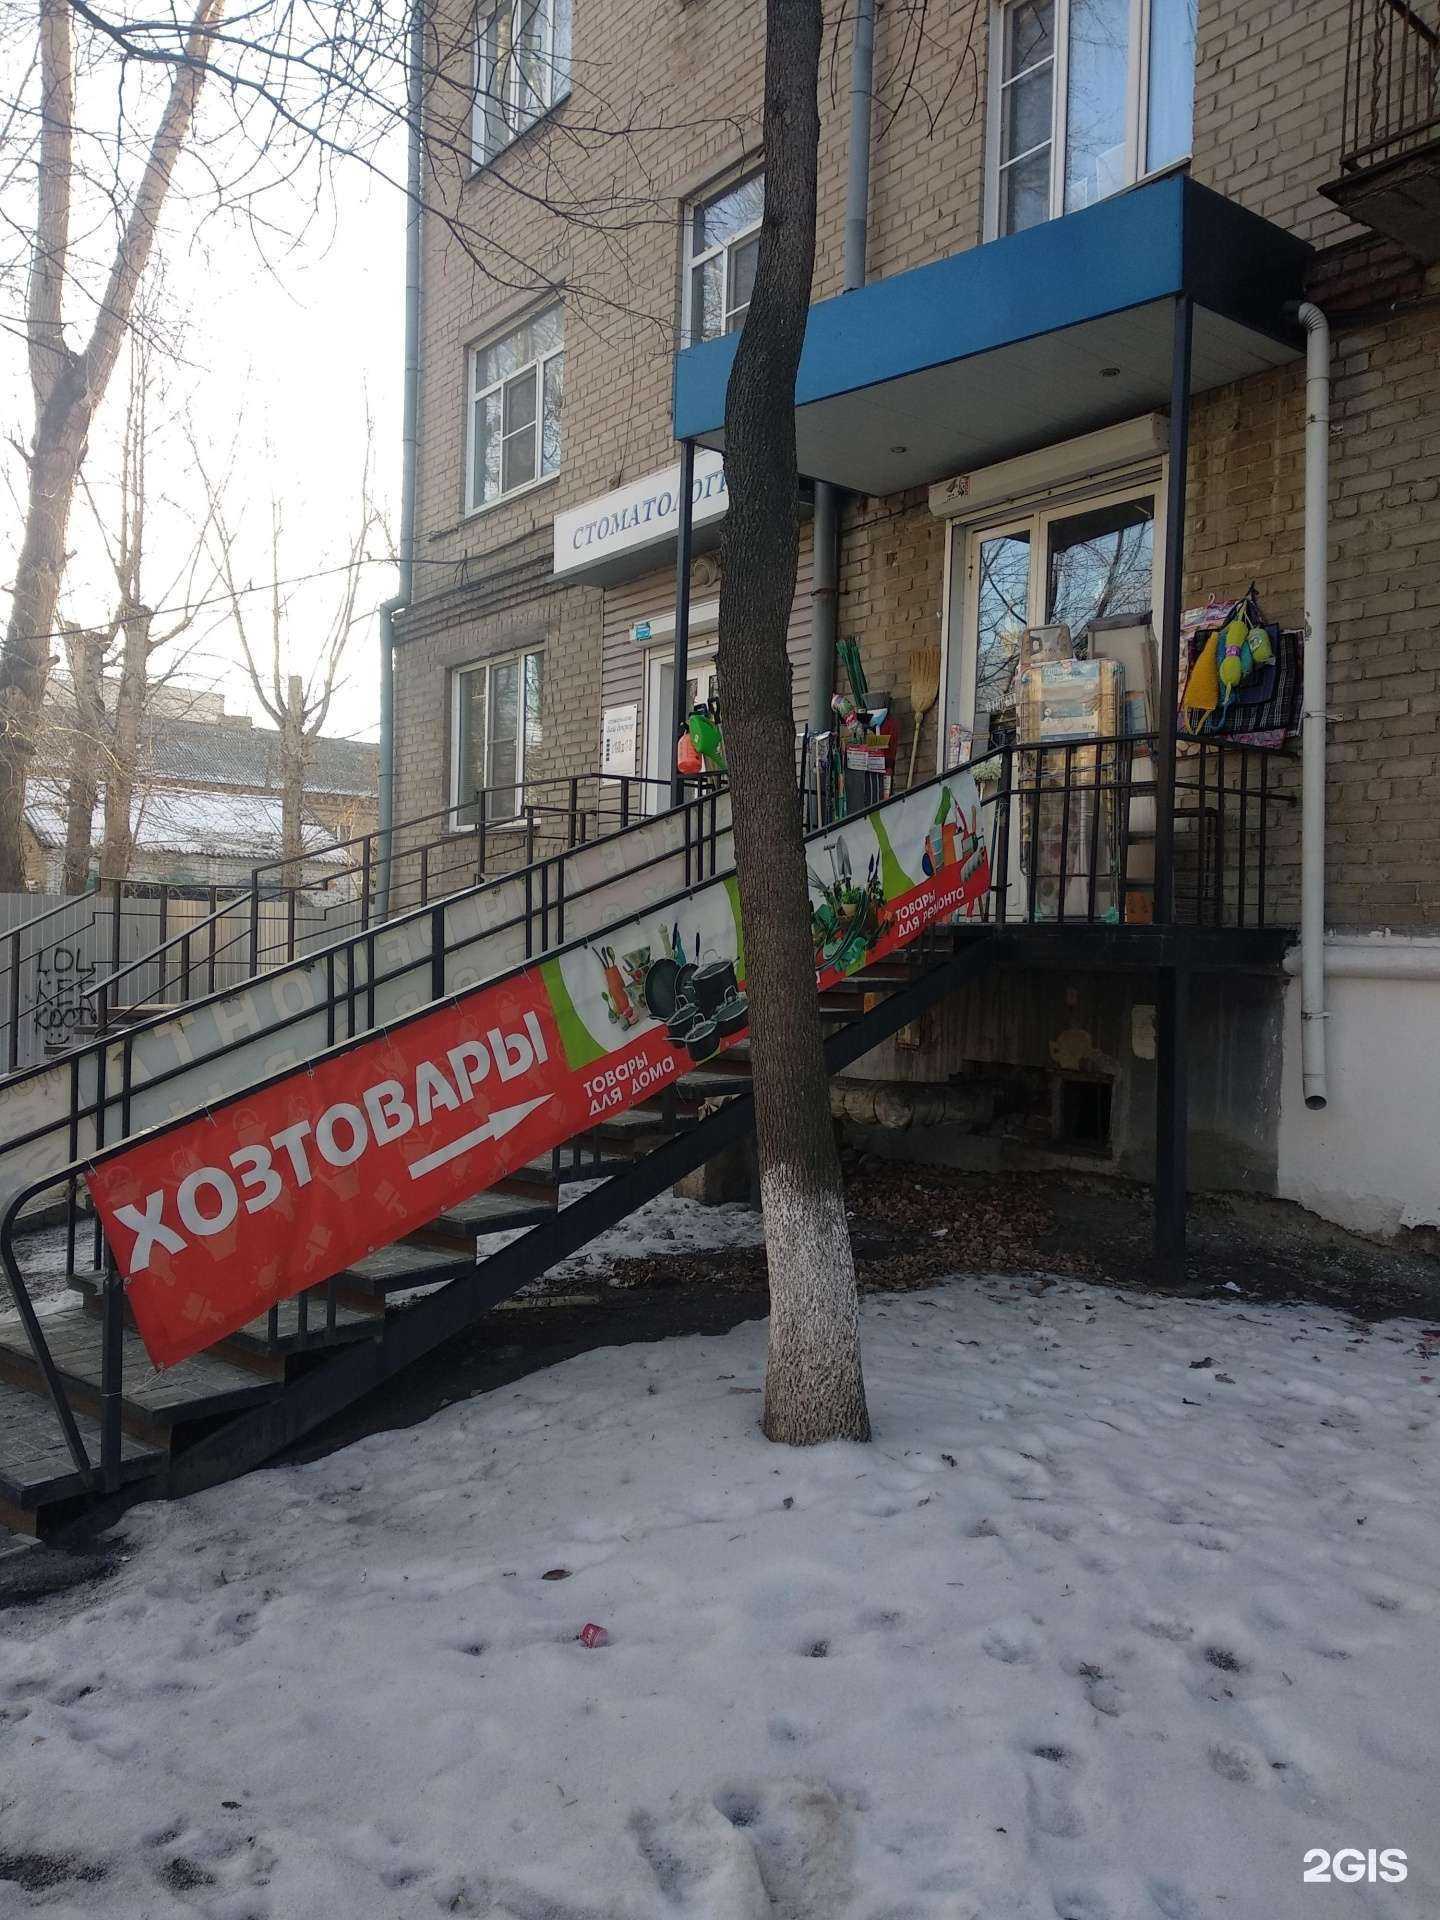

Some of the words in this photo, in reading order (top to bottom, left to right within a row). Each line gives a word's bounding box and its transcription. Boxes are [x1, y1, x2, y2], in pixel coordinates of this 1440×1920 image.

[895, 888, 936, 922] ТОВАРЫ
[898, 916, 920, 938] ДЛЯ
[37, 948, 95, 973] LOL
[583, 1050, 649, 1098] ТОВАРЫ
[589, 1086, 623, 1117] ДЛЯ
[631, 1055, 675, 1096] ДОМА
[112, 1010, 549, 1274] ХОЗТОВАРЫ
